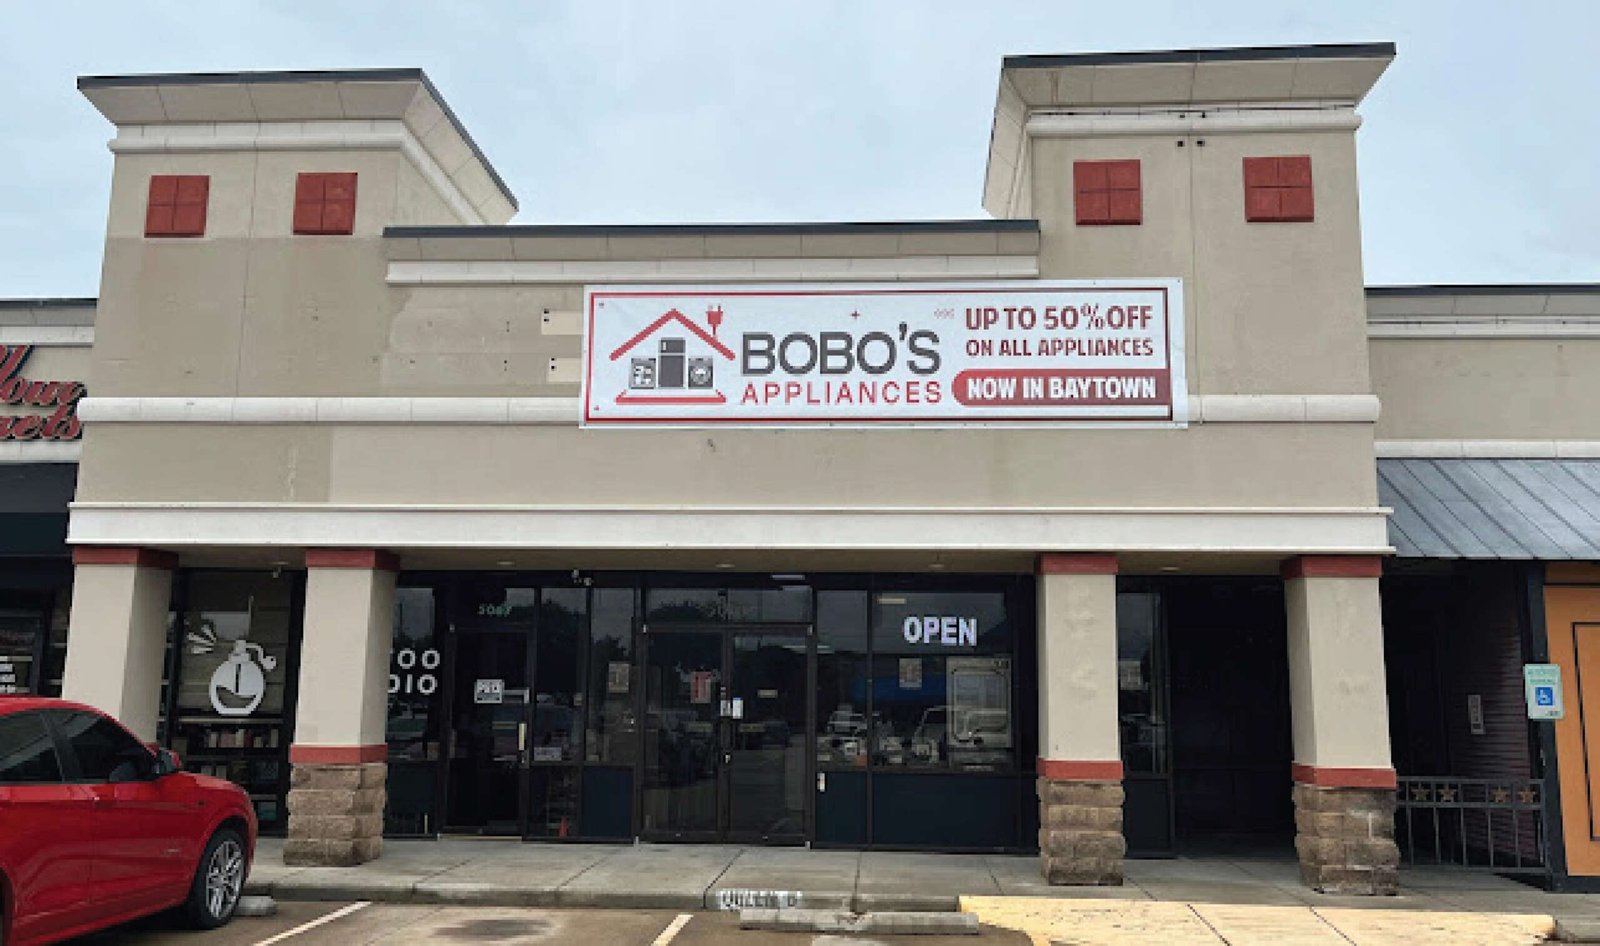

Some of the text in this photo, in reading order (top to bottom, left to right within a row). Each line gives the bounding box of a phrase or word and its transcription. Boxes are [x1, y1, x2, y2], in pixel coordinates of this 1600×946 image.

[965, 307, 1000, 331] UP
[1003, 306, 1037, 331] TO
[741, 320, 942, 377] BOBO'S
[965, 338, 1154, 357] ON ALL APPLIANCES
[741, 380, 942, 405] APPLIANCES
[967, 376, 1156, 399] NOW IN BAYTOWN
[903, 616, 978, 646] OPEN
